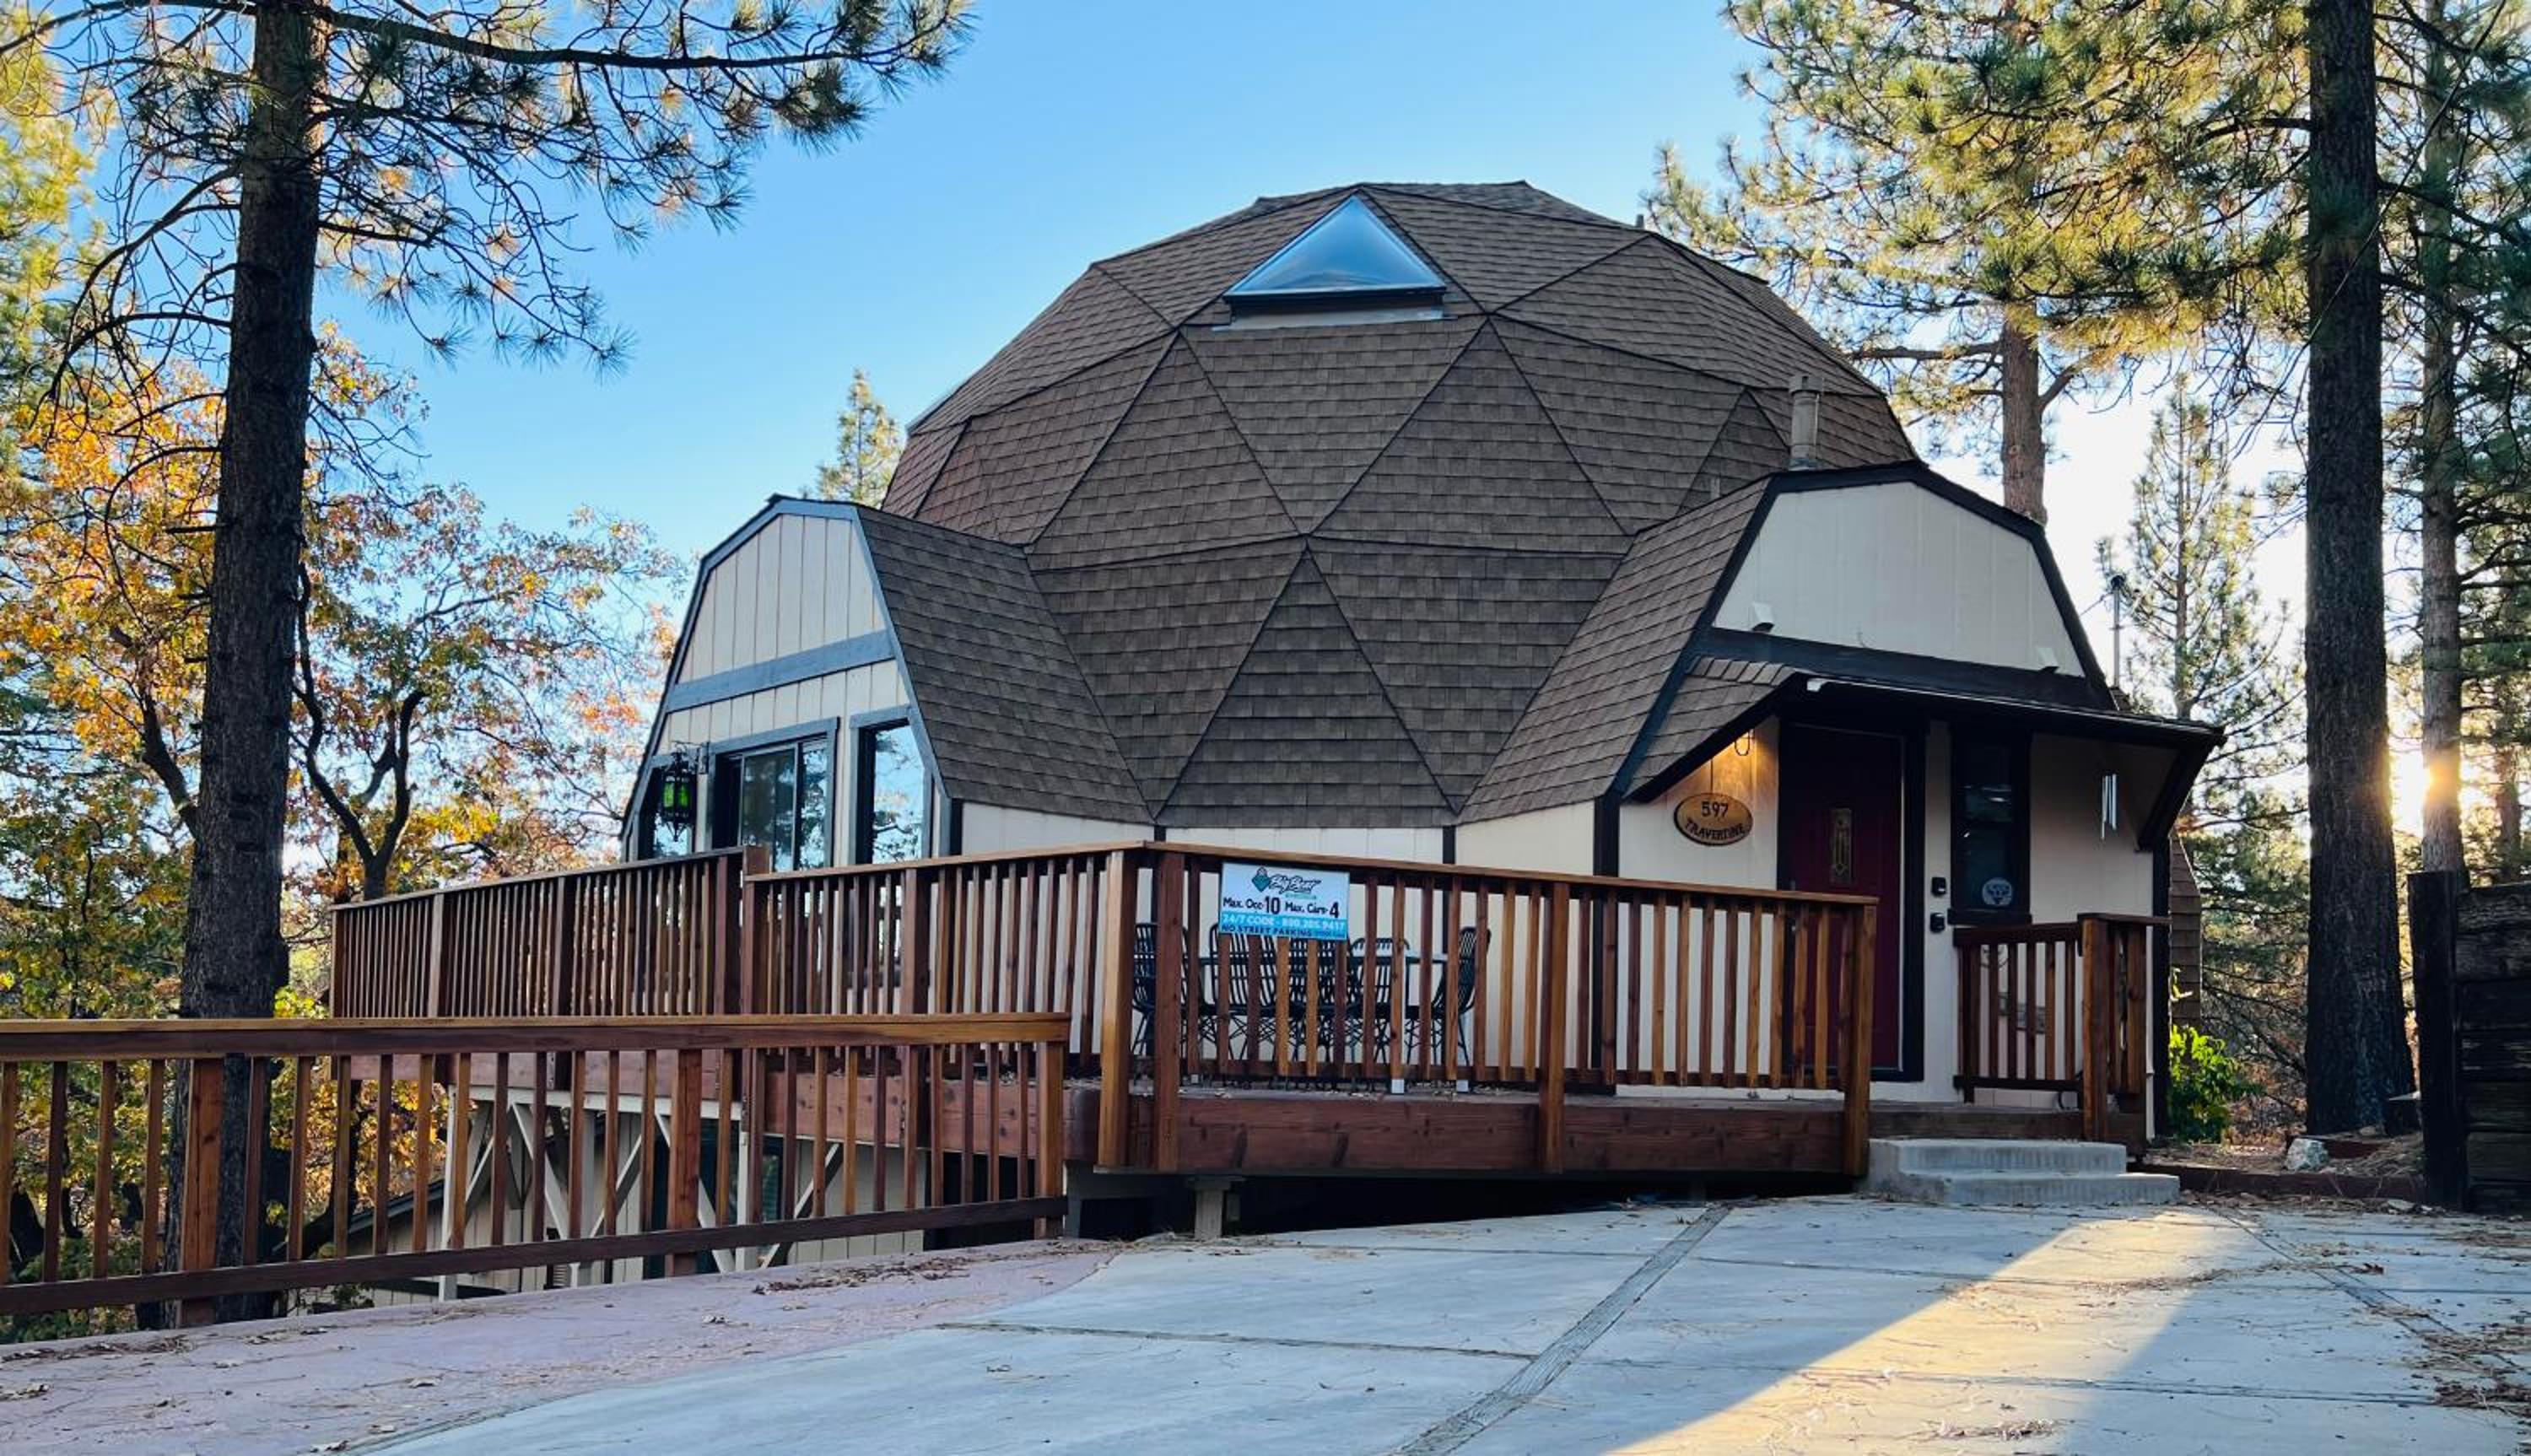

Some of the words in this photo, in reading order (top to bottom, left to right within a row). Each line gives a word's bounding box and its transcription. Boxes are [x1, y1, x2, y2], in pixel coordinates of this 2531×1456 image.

[1701, 801, 1729, 817] 597
[1686, 816, 1745, 840] TRAVERTINE
[1223, 898, 1243, 908] Max.
[1285, 902, 1305, 913] Max.
[1223, 914, 1246, 925] 24/7
[1238, 925, 1271, 934] STREET
[1273, 928, 1312, 936] PARKING
